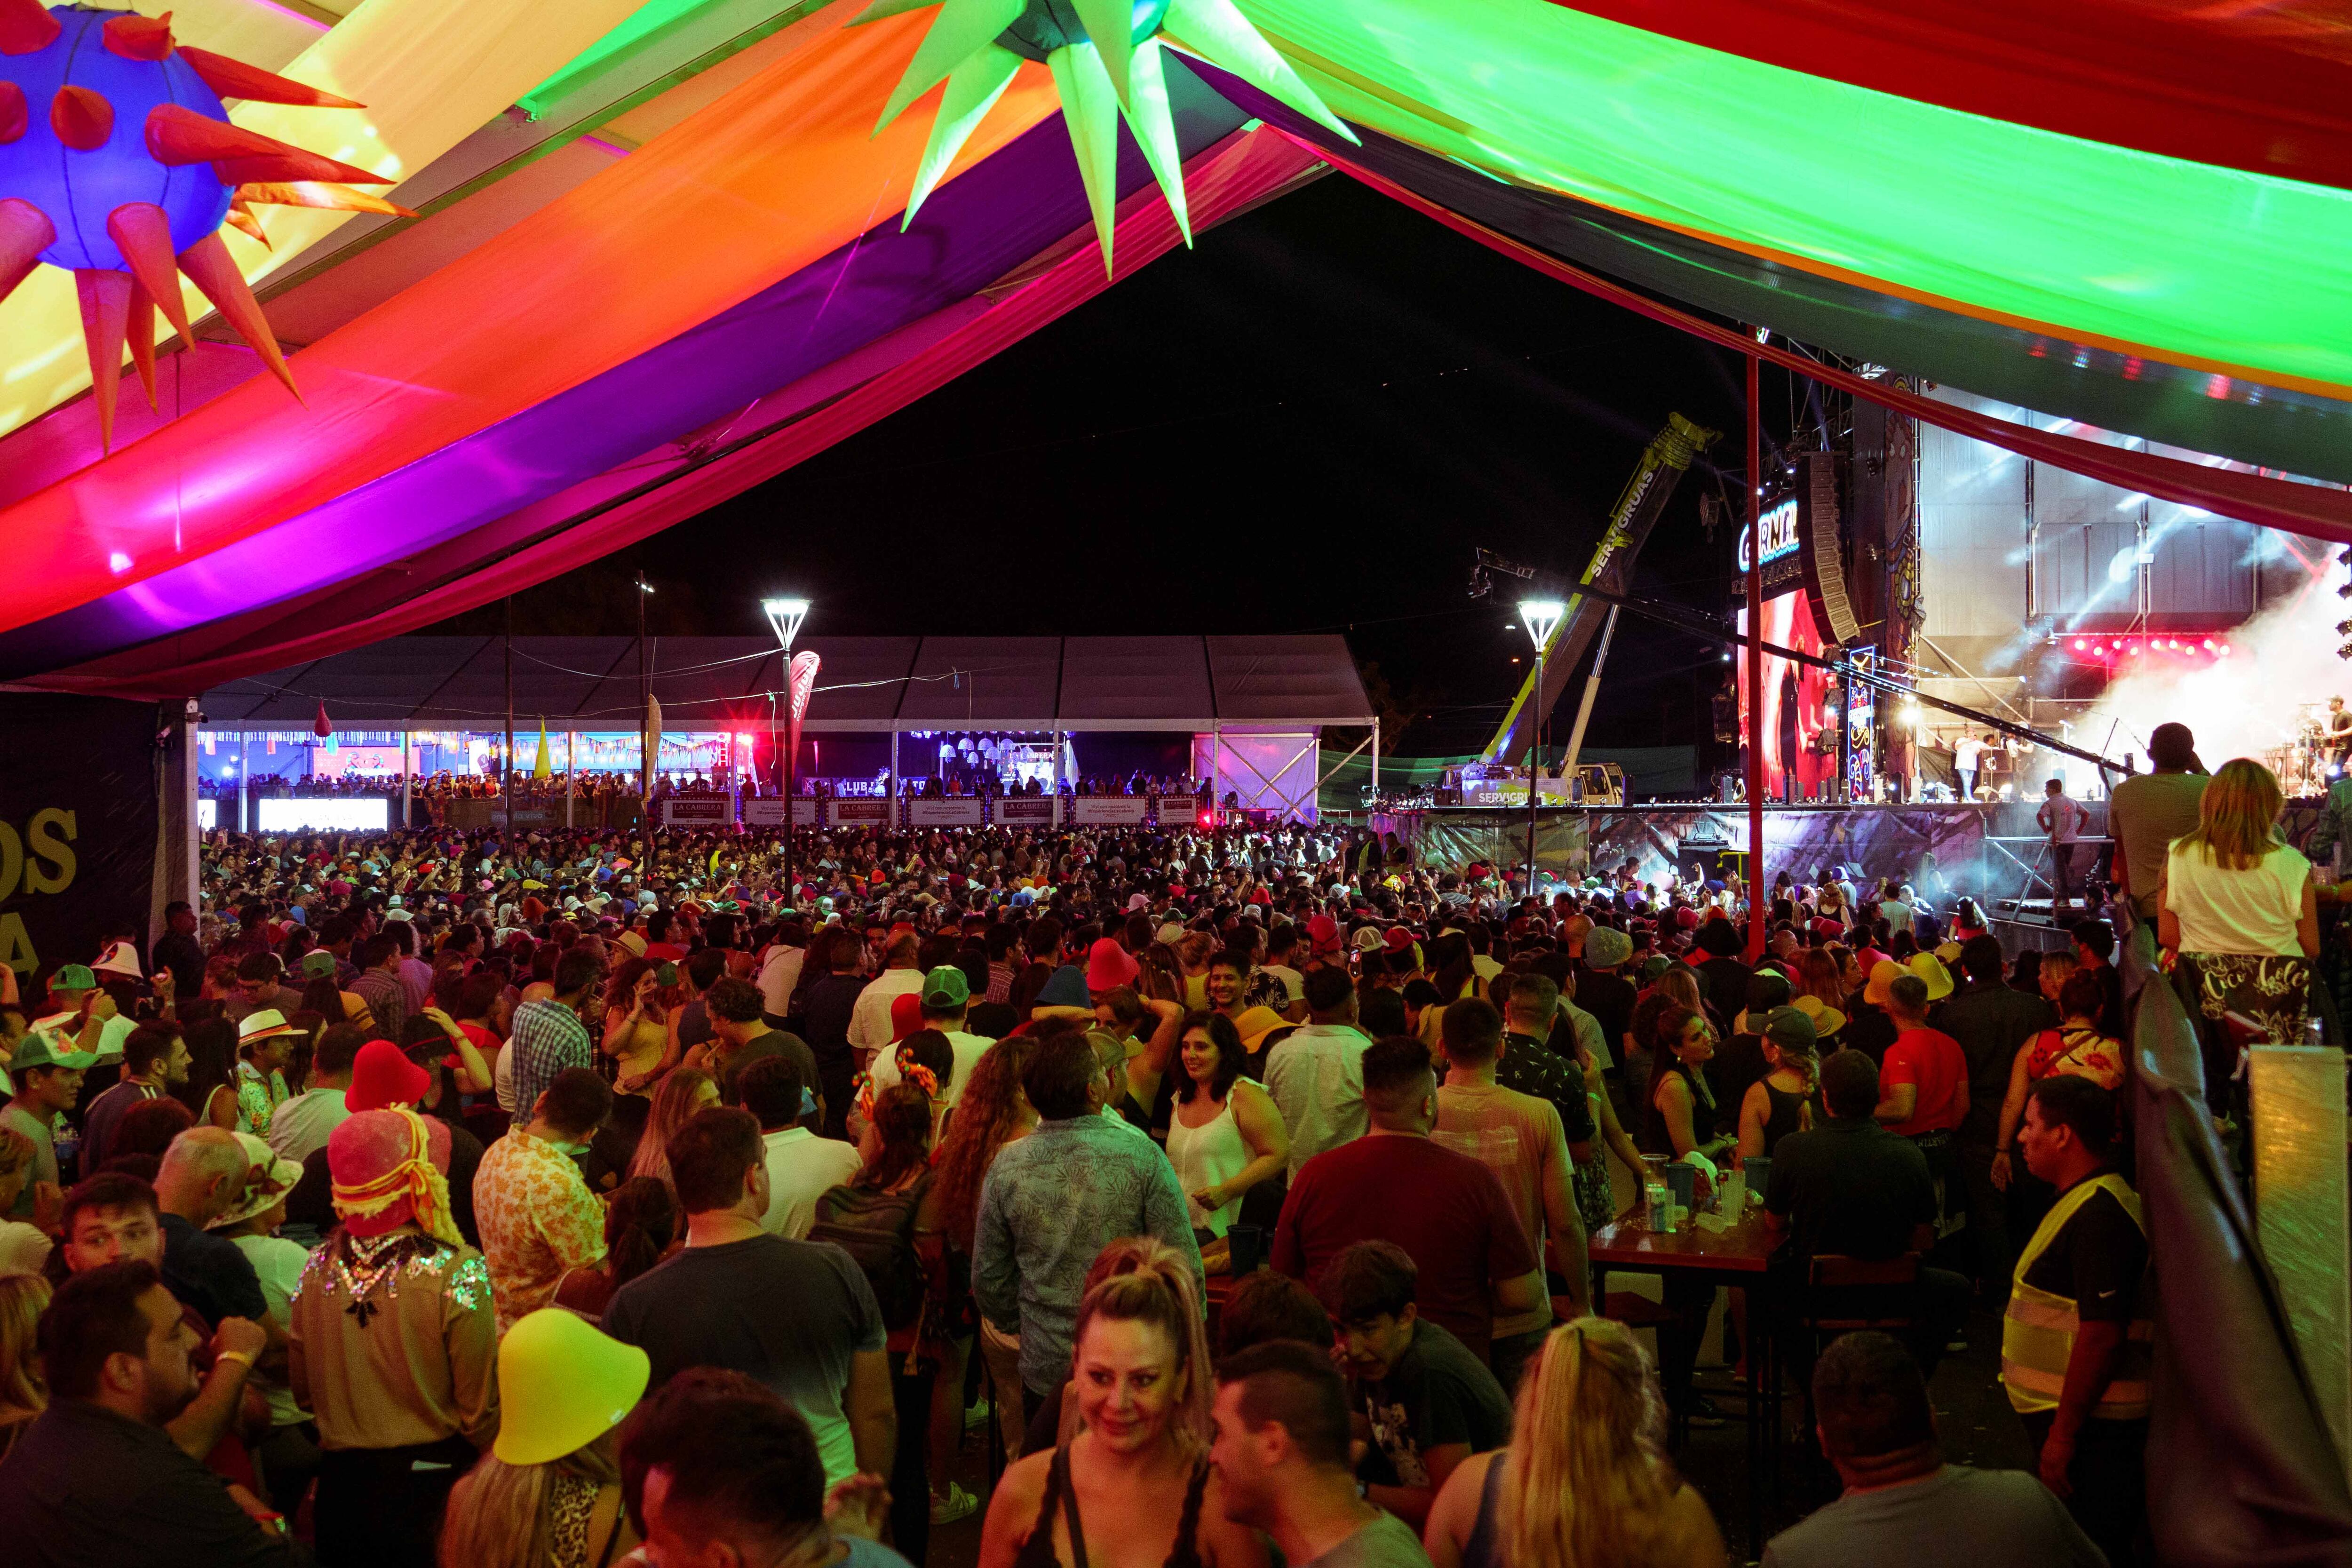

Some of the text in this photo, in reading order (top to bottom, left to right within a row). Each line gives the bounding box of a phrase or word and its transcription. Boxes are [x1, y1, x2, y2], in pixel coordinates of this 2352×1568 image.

[1591, 470, 1654, 578] SERVIGRUAS
[845, 781, 867, 791] LUB
[1478, 791, 1546, 803] SERVIGRUS
